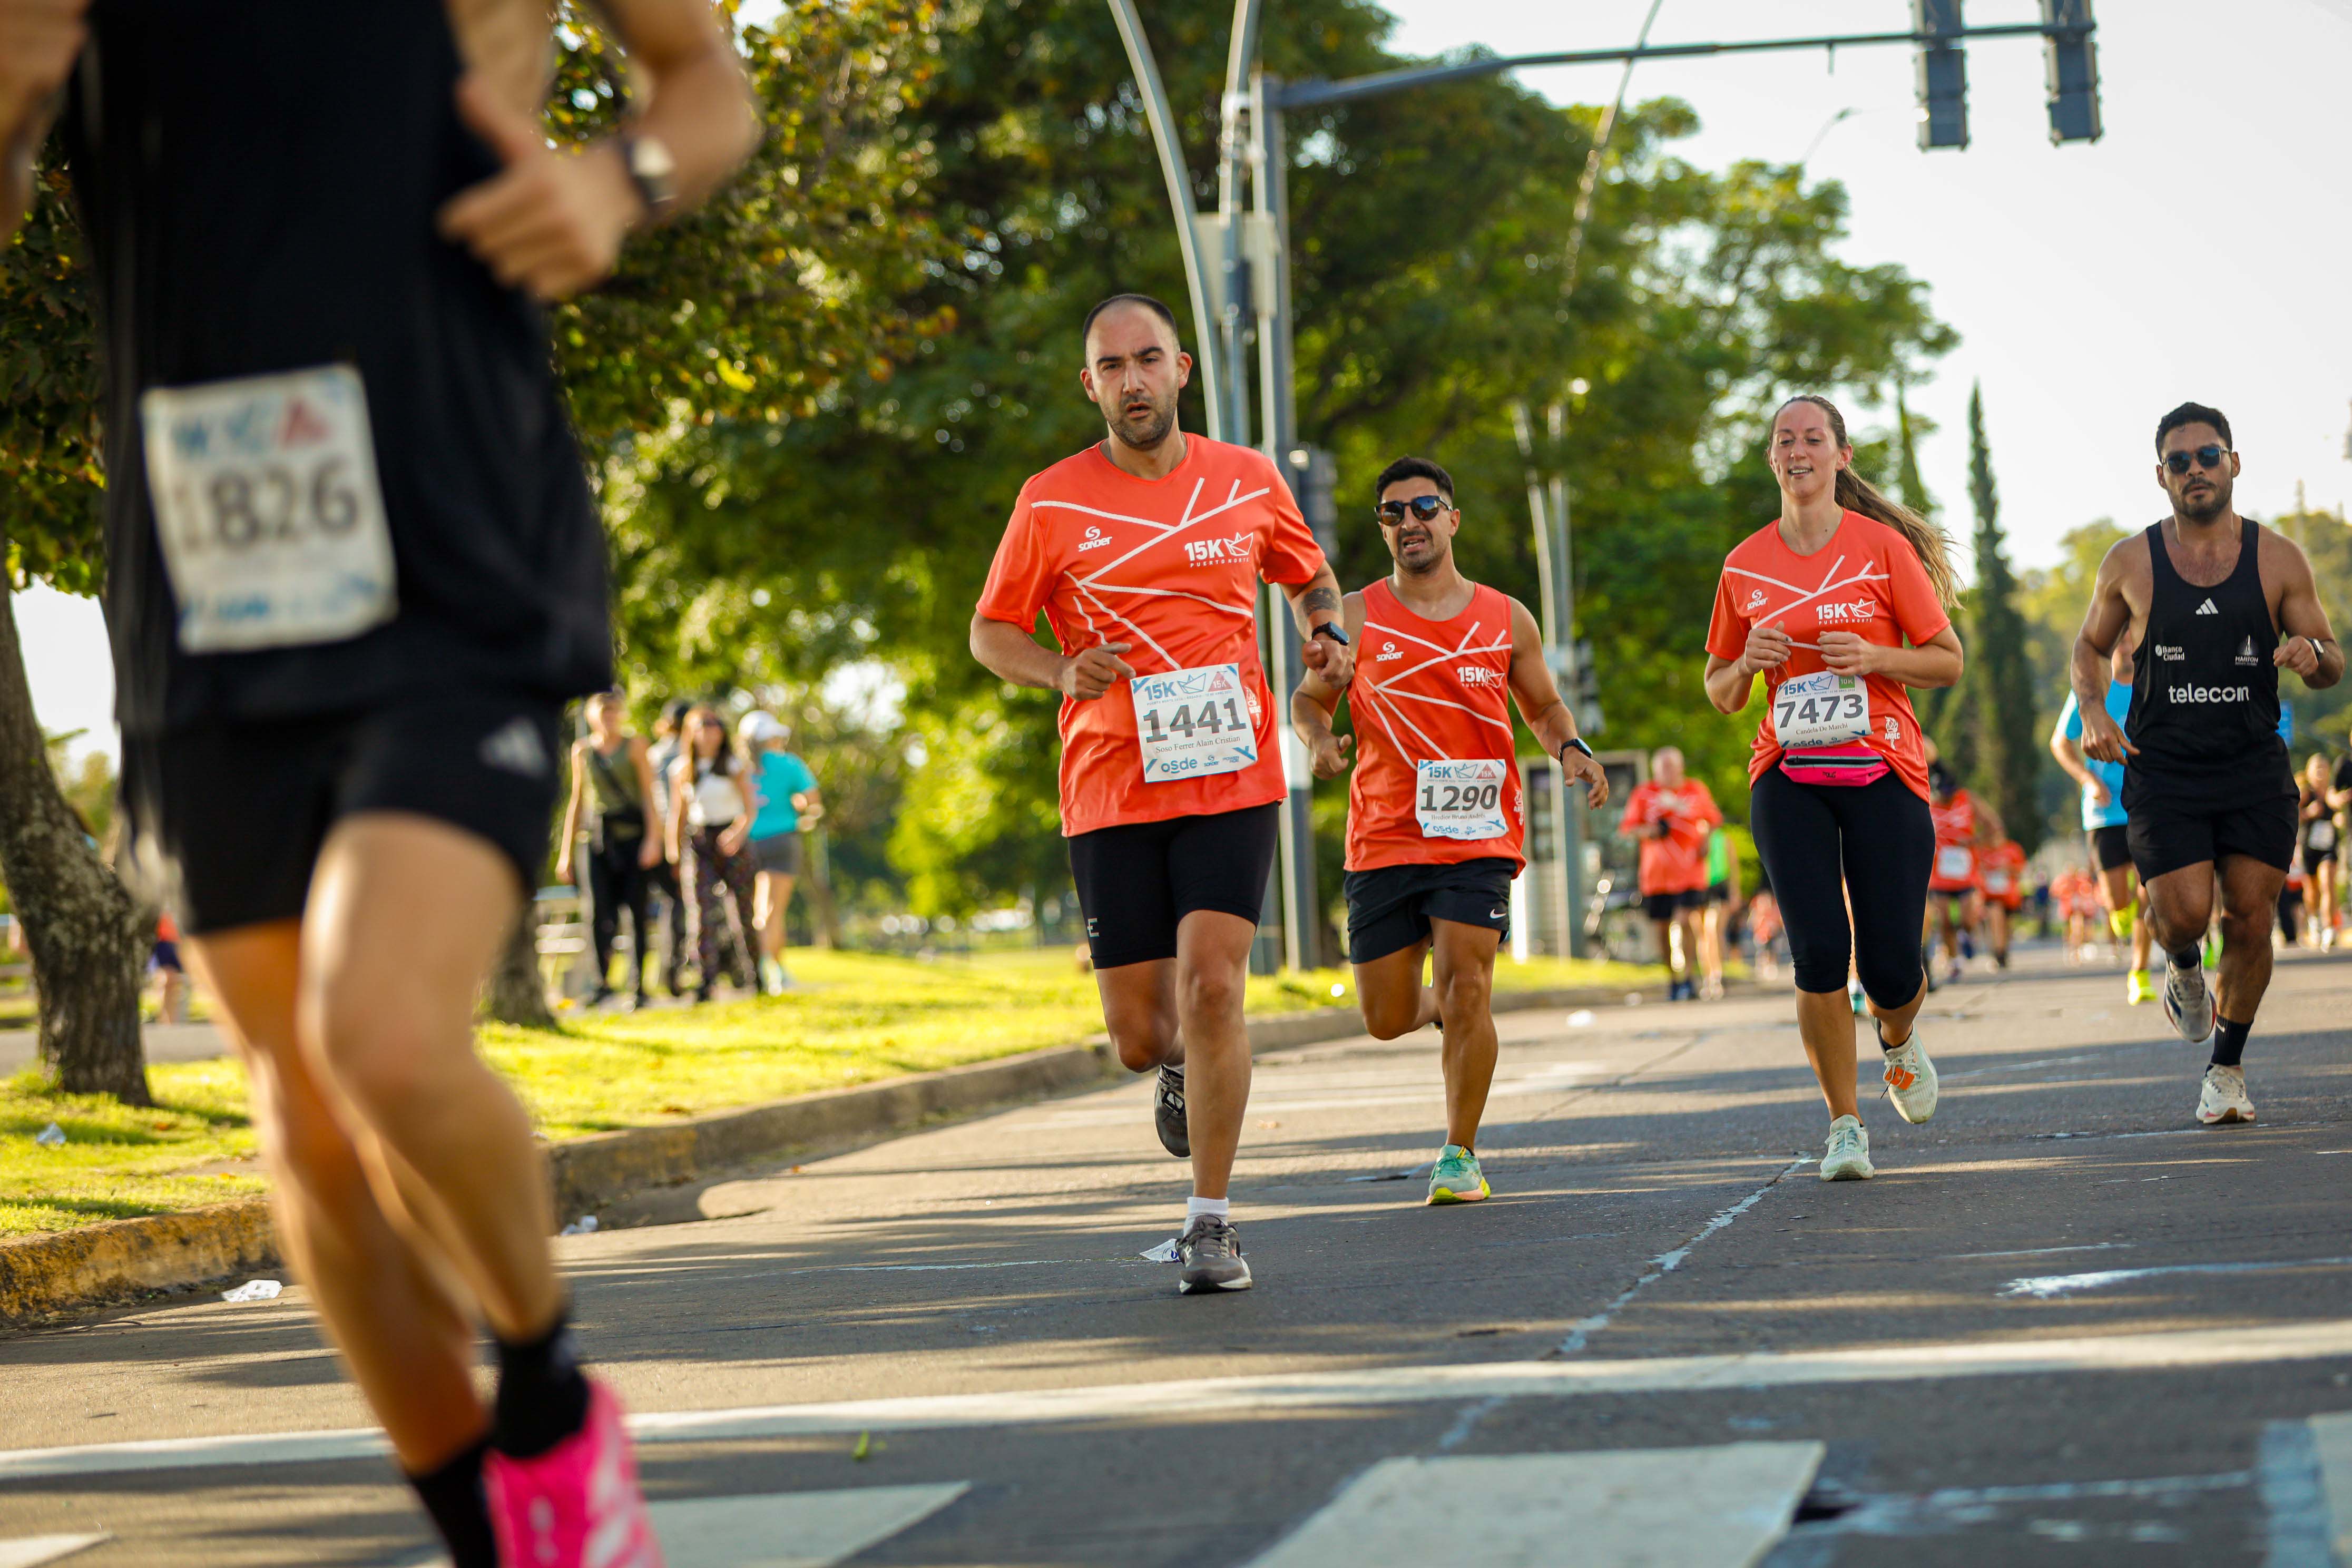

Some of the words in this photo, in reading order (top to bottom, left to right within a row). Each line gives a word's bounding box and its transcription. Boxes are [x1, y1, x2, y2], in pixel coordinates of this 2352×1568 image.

[1184, 539, 1224, 561] 15K
[1190, 559, 1225, 567] PUERTO
[1816, 603, 1848, 620] 15K
[2162, 645, 2182, 654] Banco
[2163, 652, 2185, 662] Ciudad
[1457, 667, 1486, 683] 15K
[1144, 681, 1177, 700] 15K
[1213, 679, 1227, 689] 15K
[1783, 681, 1807, 695] 15K
[2168, 683, 2249, 703] telecom
[1777, 694, 1864, 729] 7473
[1143, 698, 1247, 743] 1441
[1215, 736, 1241, 744] Cristian
[1161, 757, 1198, 773] osde
[1428, 767, 1452, 778] 15K
[1420, 784, 1498, 811] 1290
[1433, 825, 1459, 834] osde
